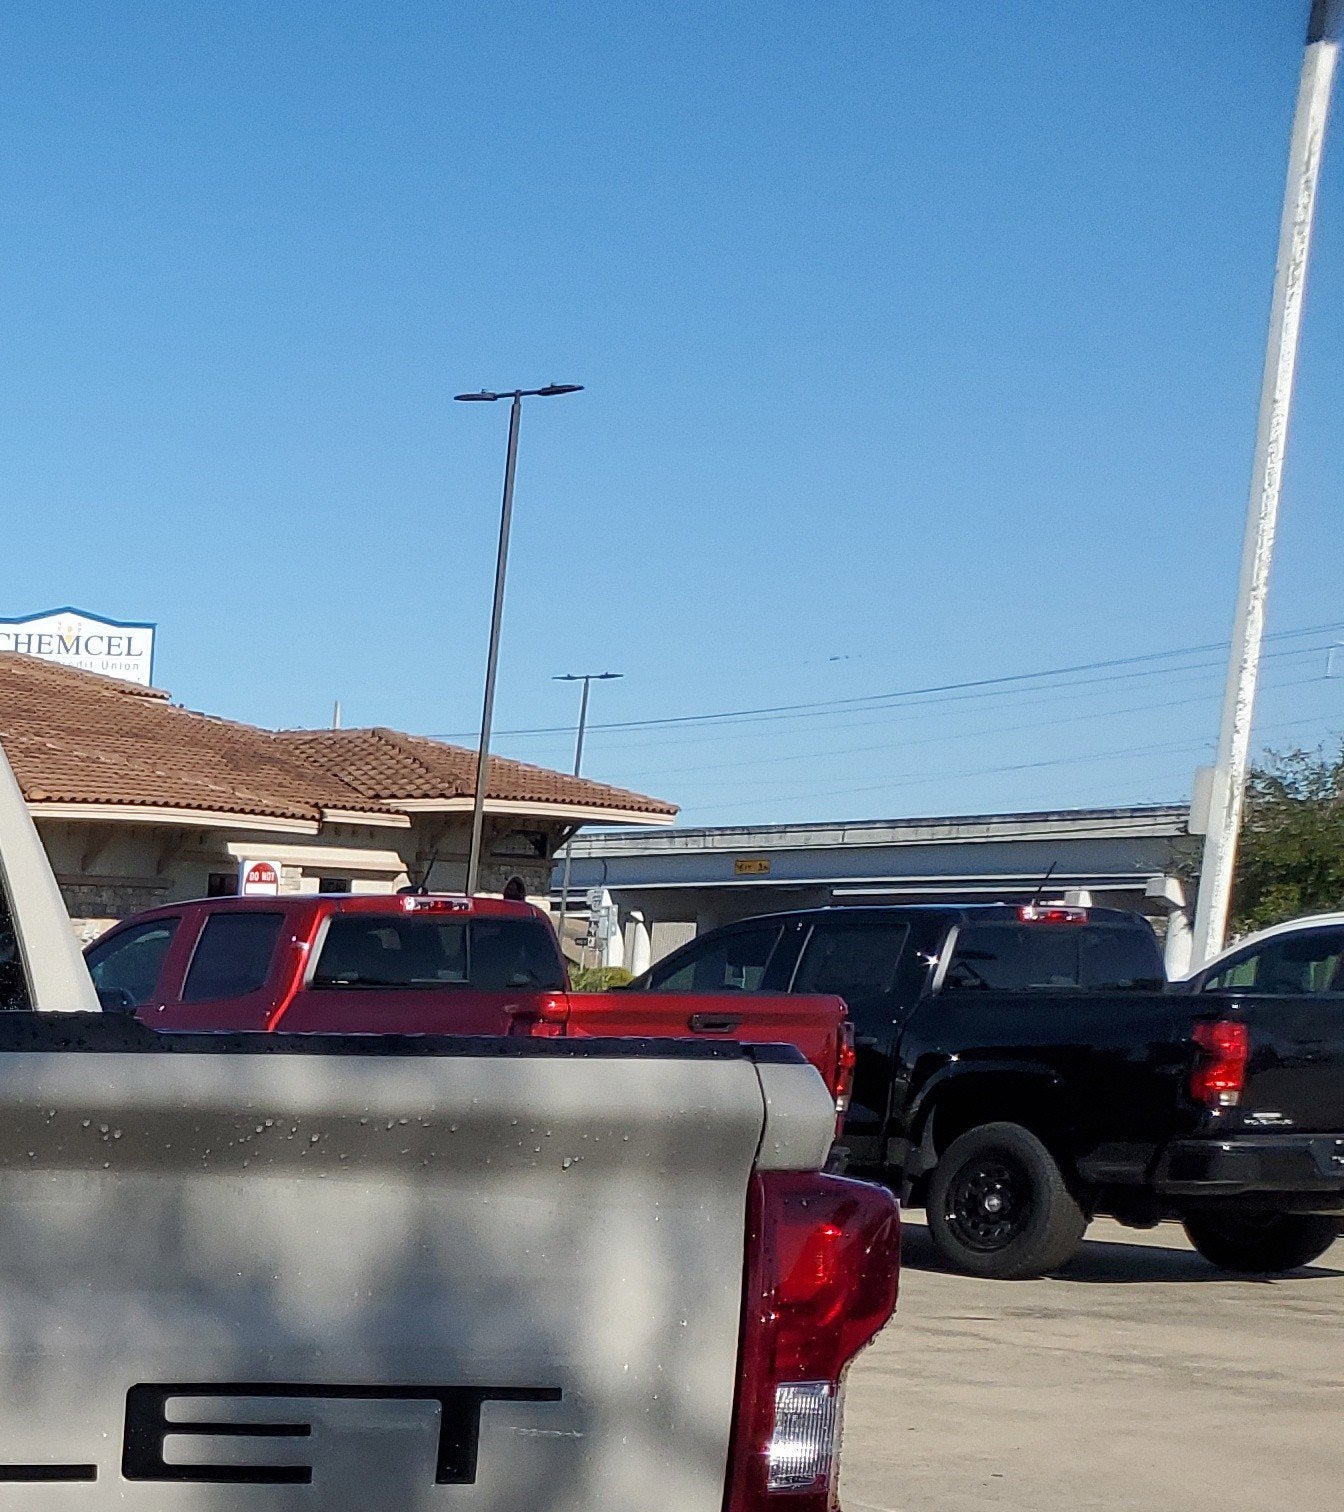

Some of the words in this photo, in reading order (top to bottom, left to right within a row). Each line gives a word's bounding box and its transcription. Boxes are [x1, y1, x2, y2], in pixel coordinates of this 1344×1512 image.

[101, 660, 139, 671] Union
[249, 871, 260, 882] DO
[261, 871, 275, 882] NOT
